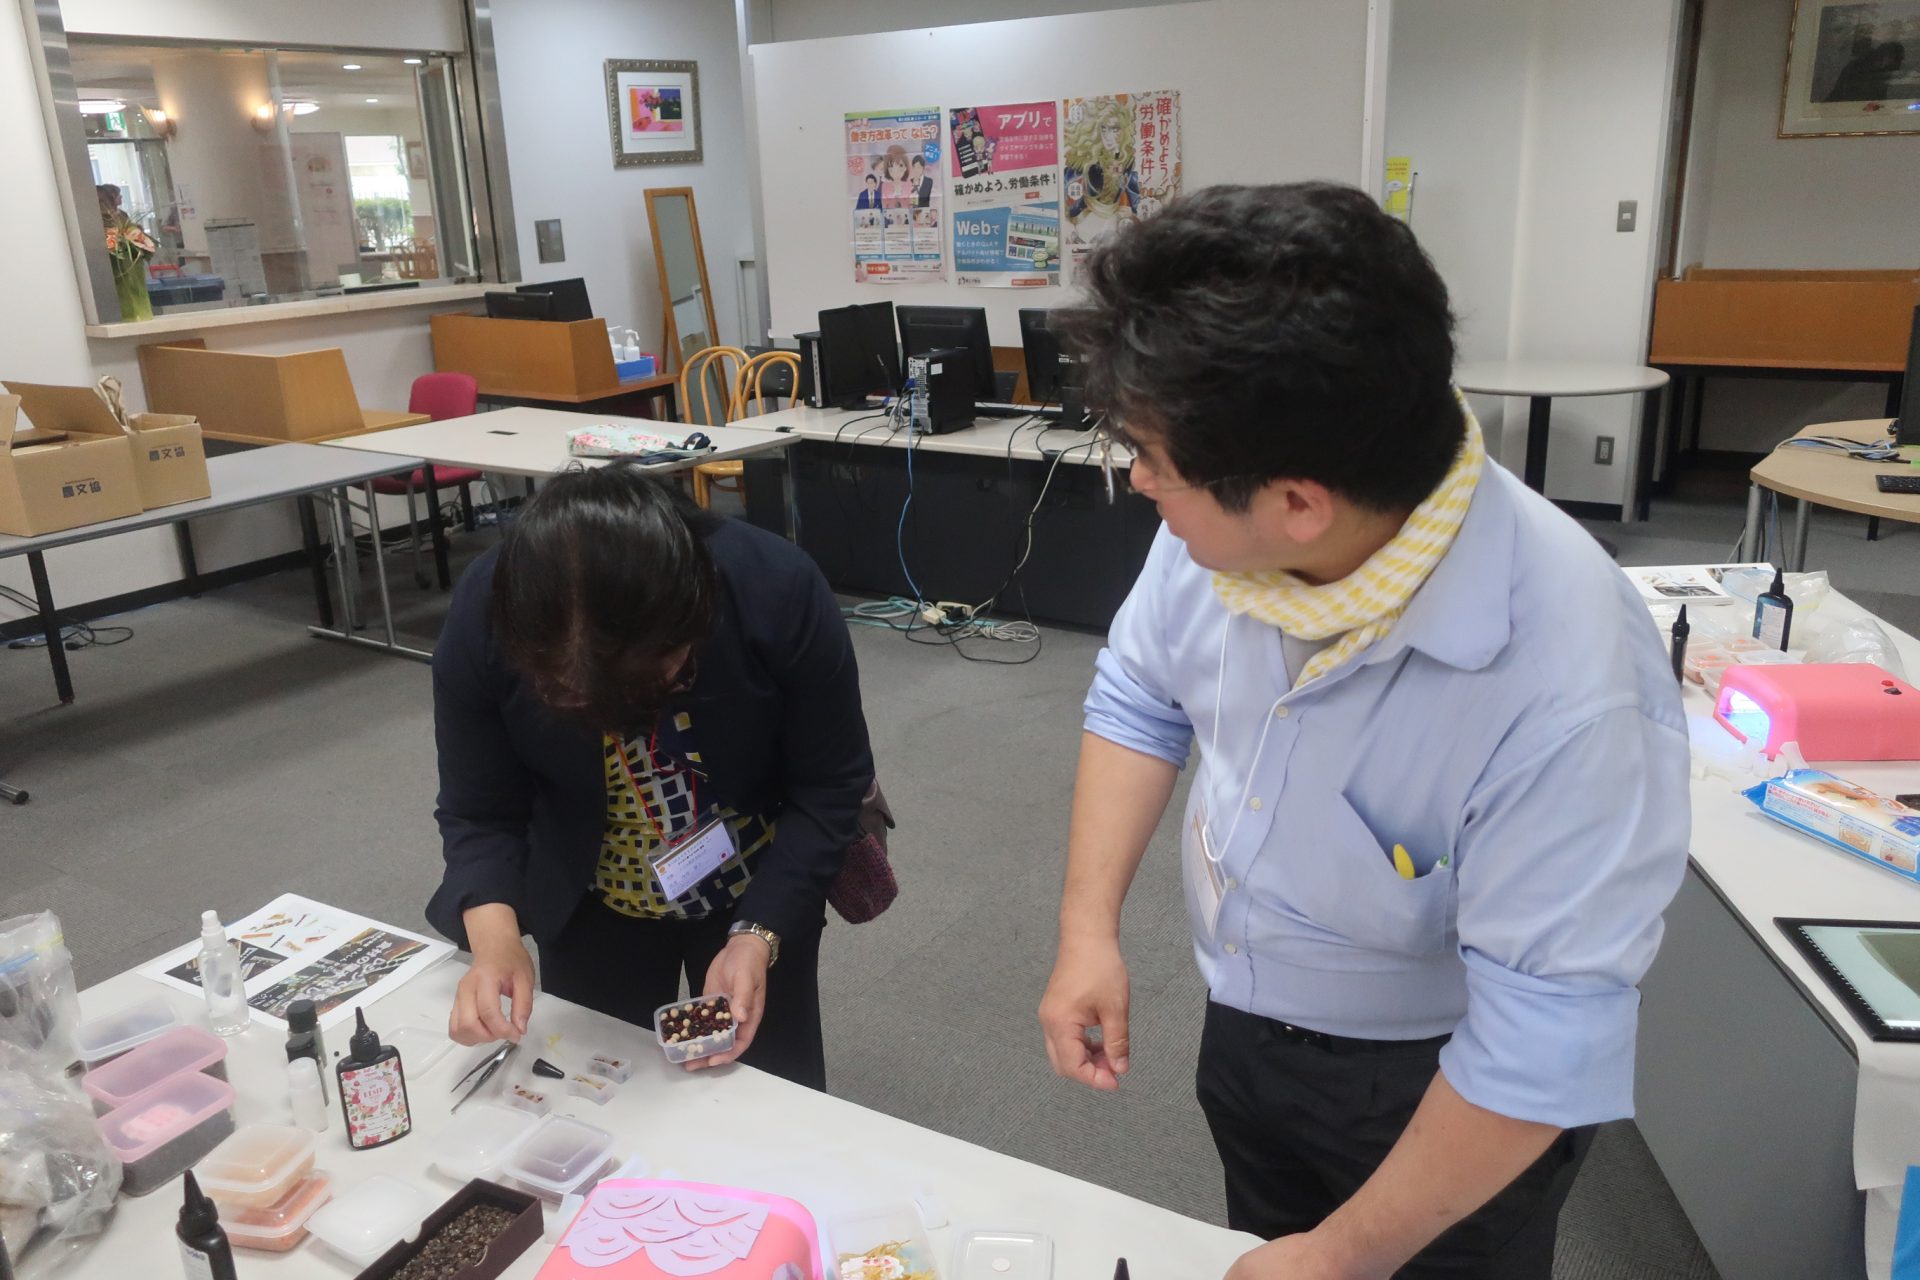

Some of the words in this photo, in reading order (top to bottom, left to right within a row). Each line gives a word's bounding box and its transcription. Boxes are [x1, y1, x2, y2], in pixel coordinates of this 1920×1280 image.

[997, 110, 1052, 130] アプリで
[956, 220, 1000, 236] Webで
